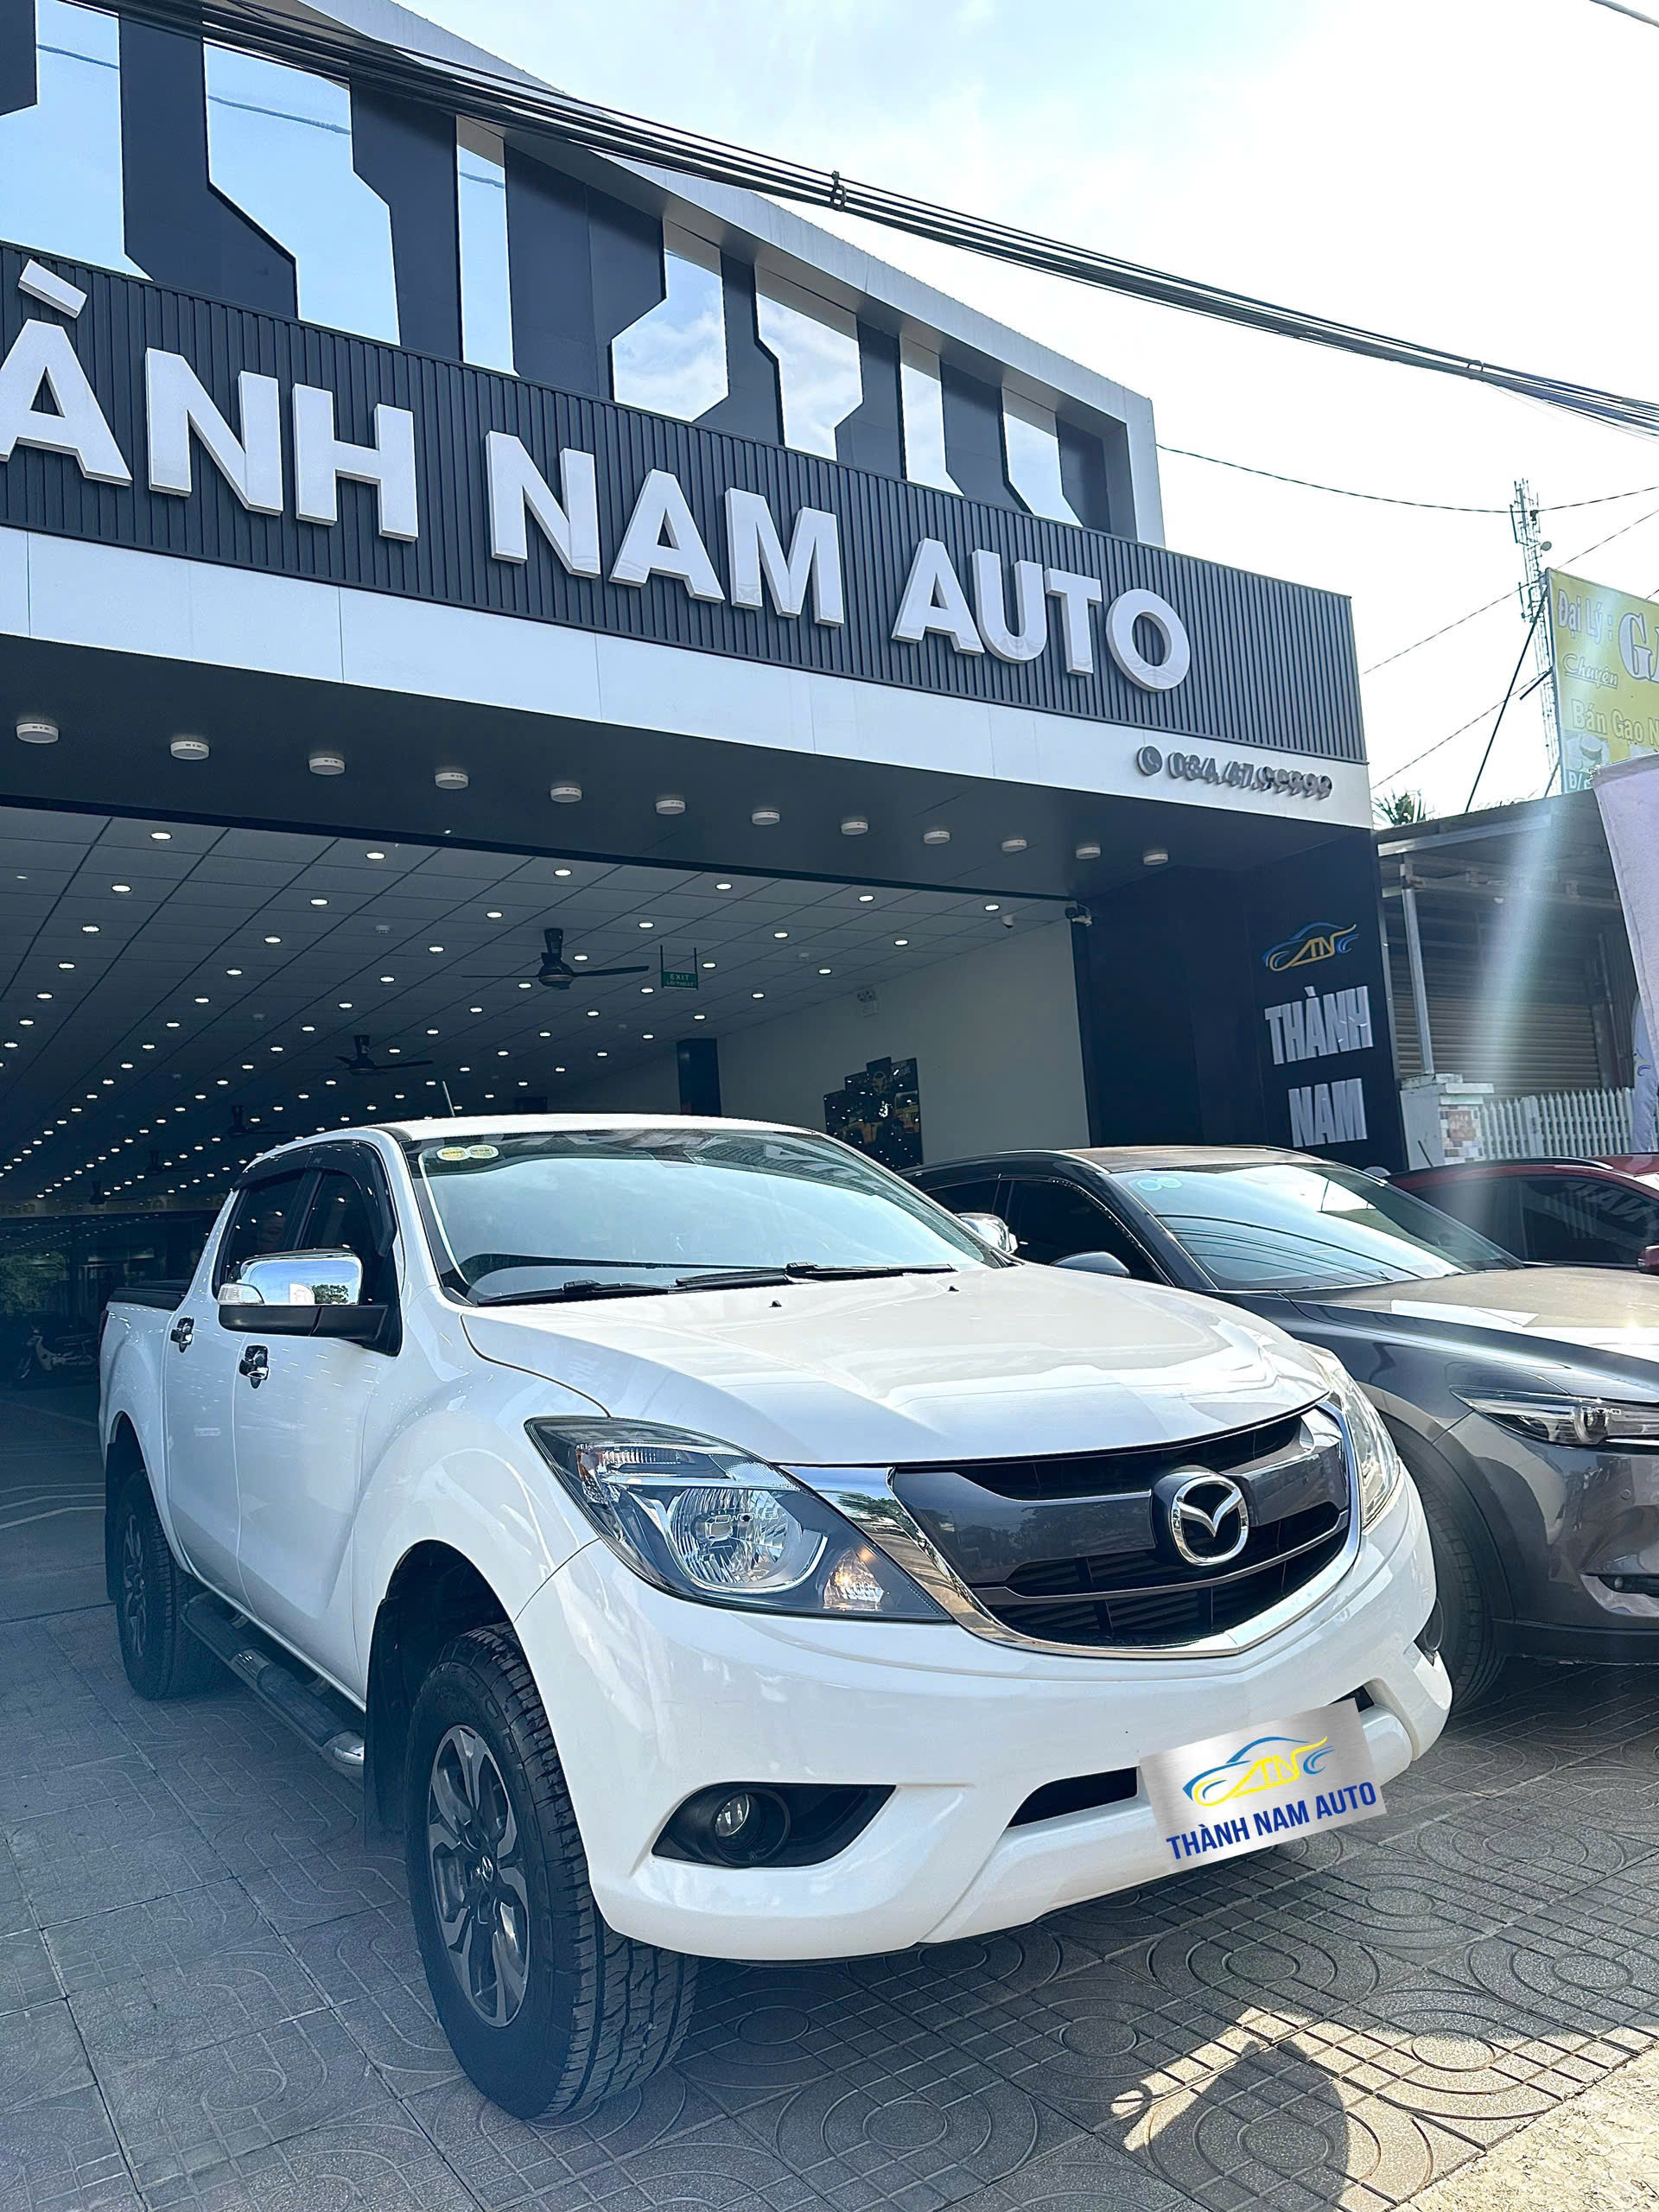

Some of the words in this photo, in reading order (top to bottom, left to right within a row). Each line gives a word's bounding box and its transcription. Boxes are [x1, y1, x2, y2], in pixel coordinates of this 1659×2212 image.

[486, 429, 845, 627] NAM
[891, 537, 1192, 692] AUTO
[1558, 589, 1582, 639] Đại
[1562, 653, 1618, 690] Chuyên
[1571, 698, 1607, 734] Bán
[1611, 709, 1644, 747] Gạo
[1264, 985, 1373, 1065] THÀNH
[1287, 1078, 1368, 1148] NAM
[1166, 1816, 1255, 1859] THÀNH
[1254, 1800, 1310, 1836] NAM
[1316, 1782, 1376, 1820] AUTO
